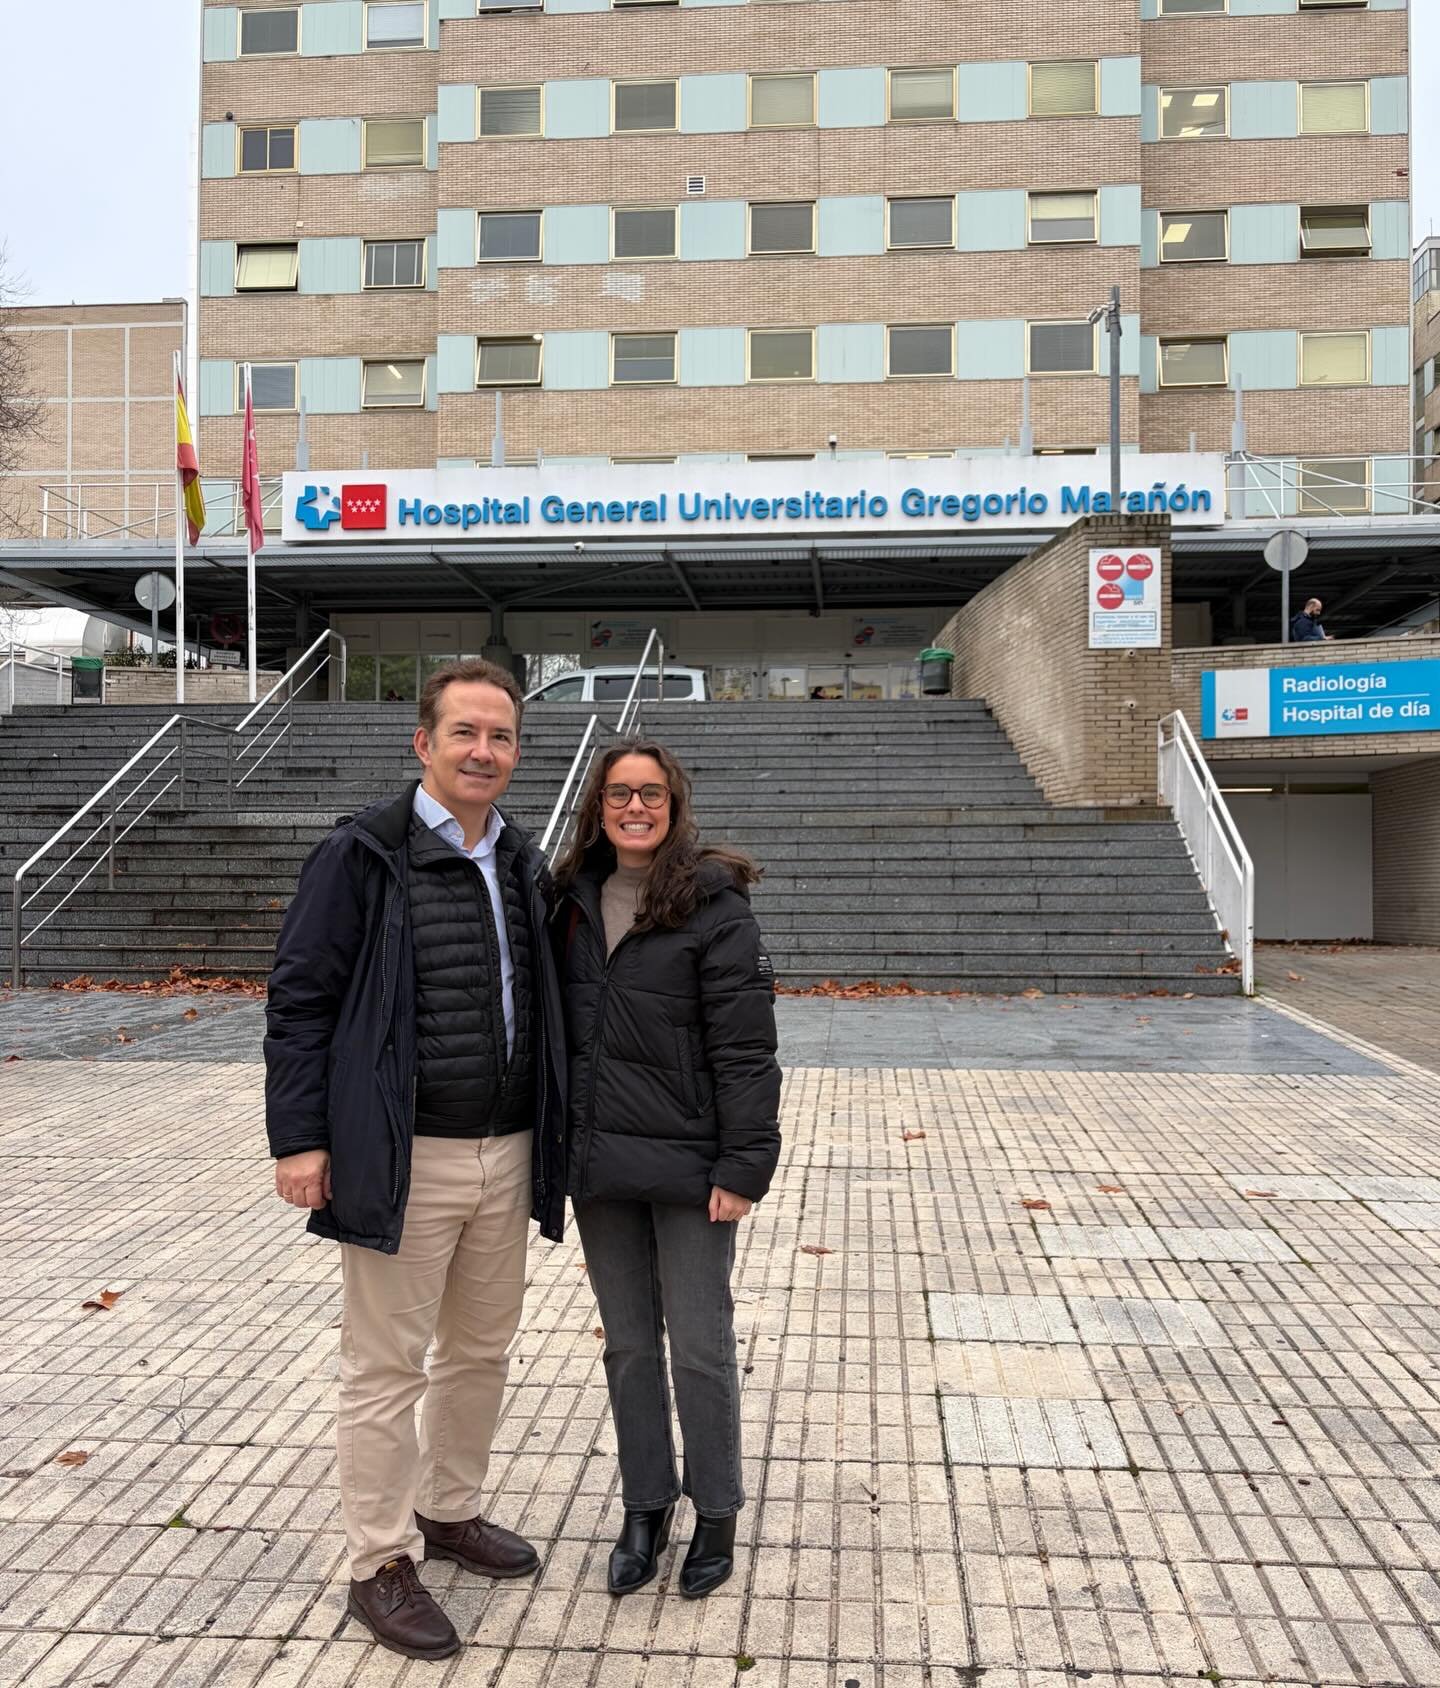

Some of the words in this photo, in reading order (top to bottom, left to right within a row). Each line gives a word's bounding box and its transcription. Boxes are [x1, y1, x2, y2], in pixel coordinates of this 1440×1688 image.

[398, 496, 530, 529] Hospital
[540, 494, 667, 523] General
[678, 490, 888, 521] Universitario
[901, 488, 1048, 521] Gregorio
[1282, 673, 1387, 693] Radiología
[1282, 704, 1363, 724] Hospital
[1369, 703, 1394, 719] de
[1400, 701, 1431, 717] día
